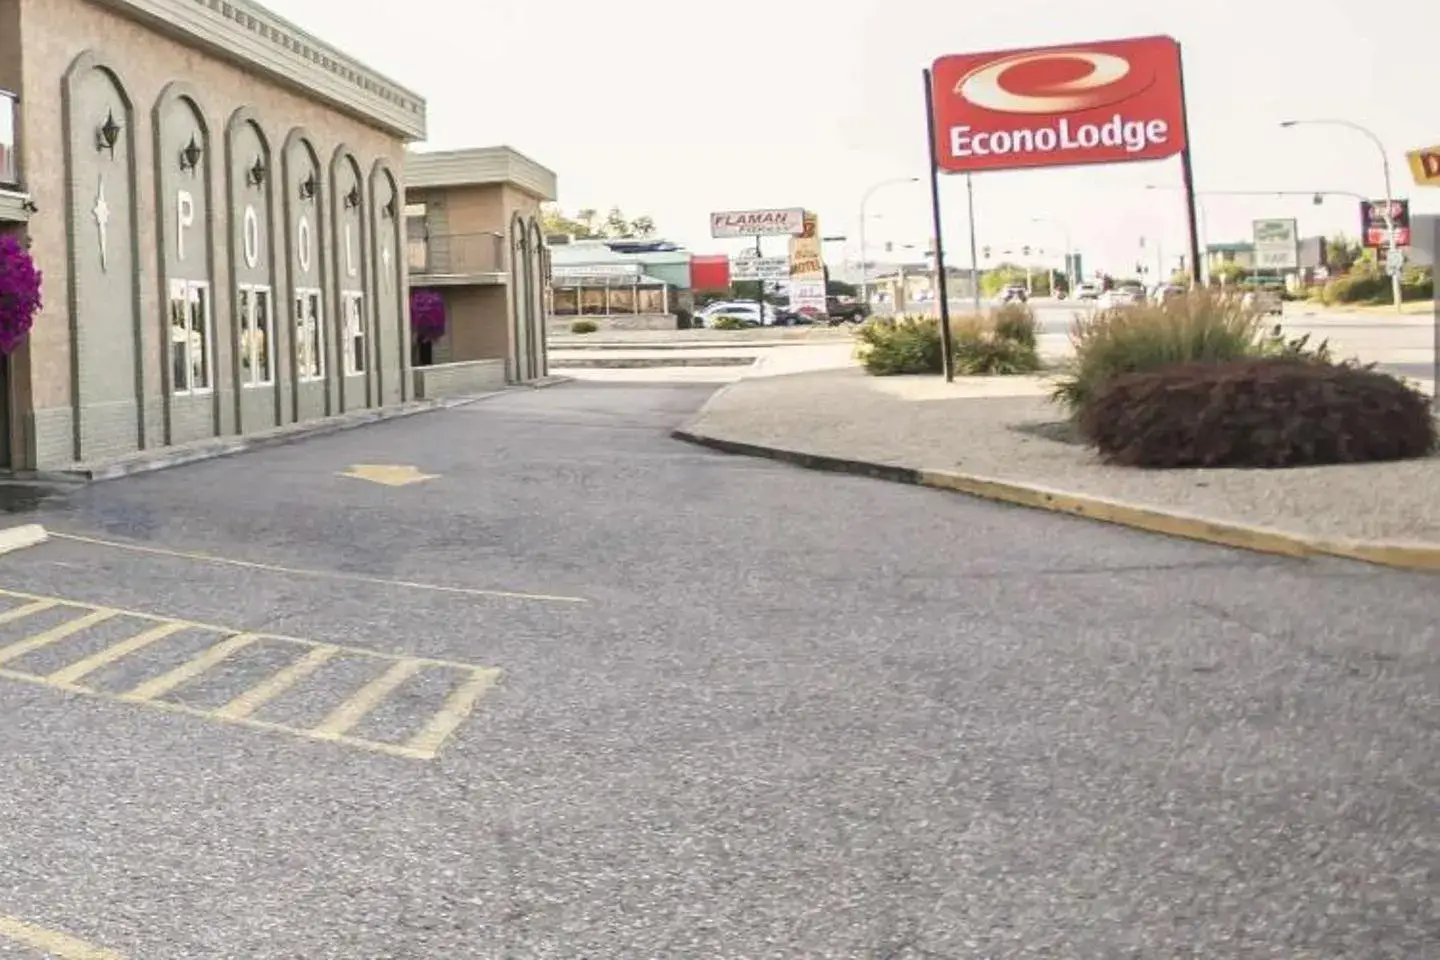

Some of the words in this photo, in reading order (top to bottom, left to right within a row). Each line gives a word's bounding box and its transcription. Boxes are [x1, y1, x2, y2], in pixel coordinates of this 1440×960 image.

[950, 114, 1168, 157] EconoLodge
[177, 190, 357, 277] POOL
[715, 212, 788, 226] FLAMAN
